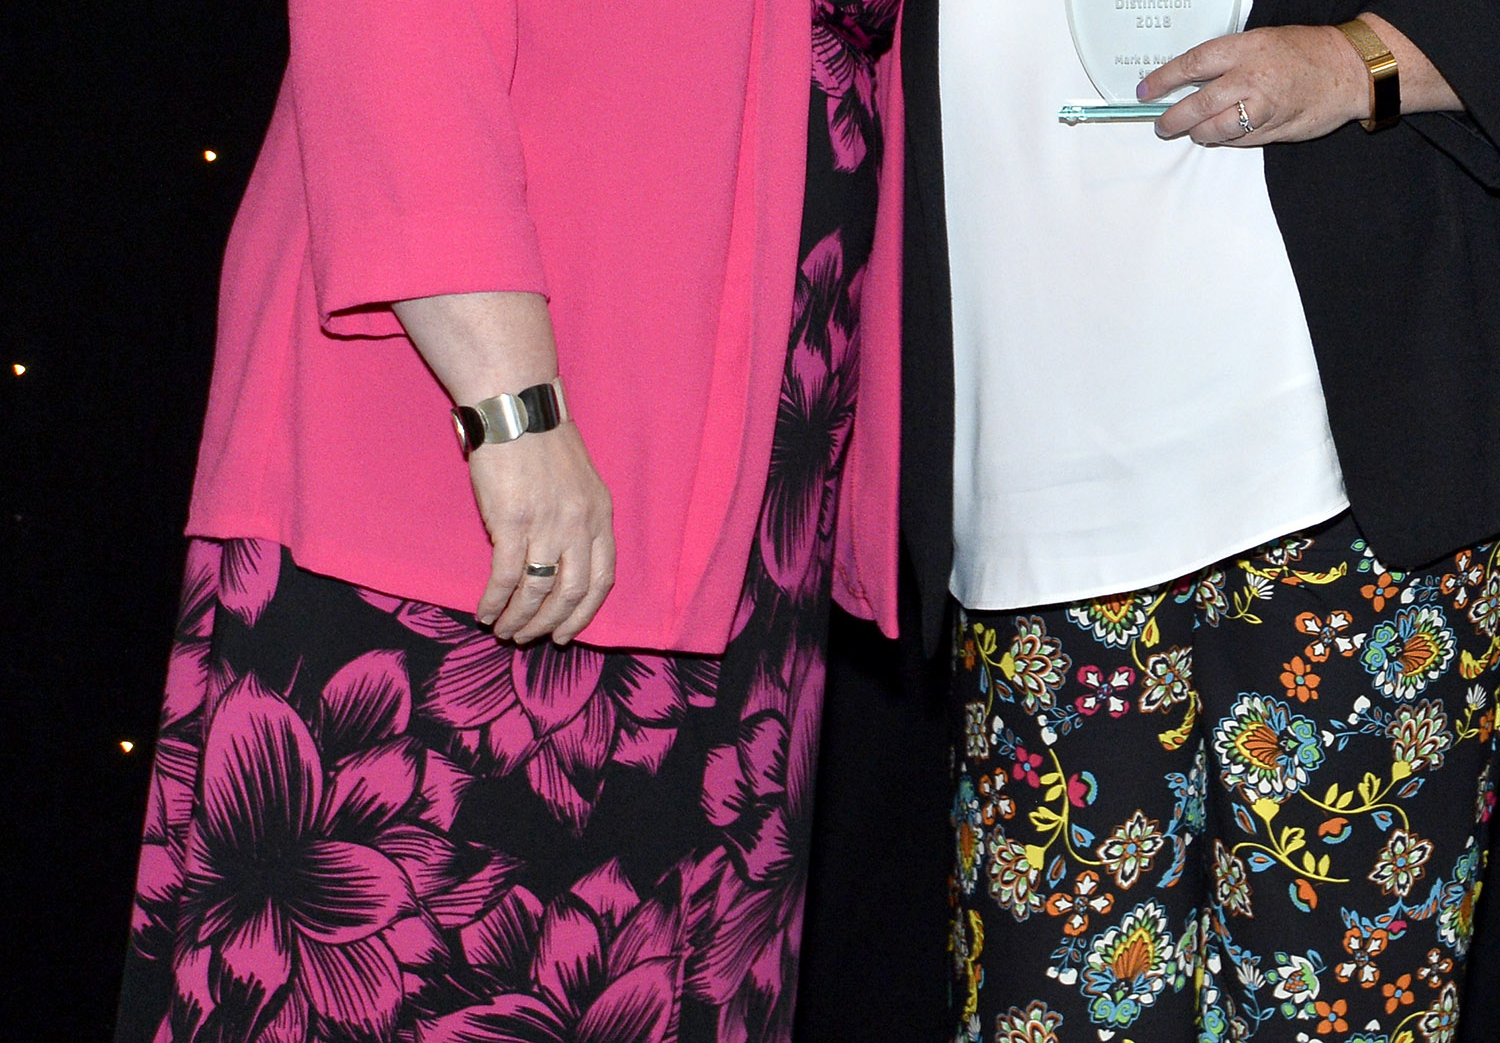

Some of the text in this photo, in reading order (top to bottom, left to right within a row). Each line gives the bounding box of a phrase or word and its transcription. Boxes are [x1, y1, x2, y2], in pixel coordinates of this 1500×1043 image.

[1136, 16, 1171, 29] 2018
[1114, 54, 1141, 65] Mark
[1143, 54, 1151, 65] &
